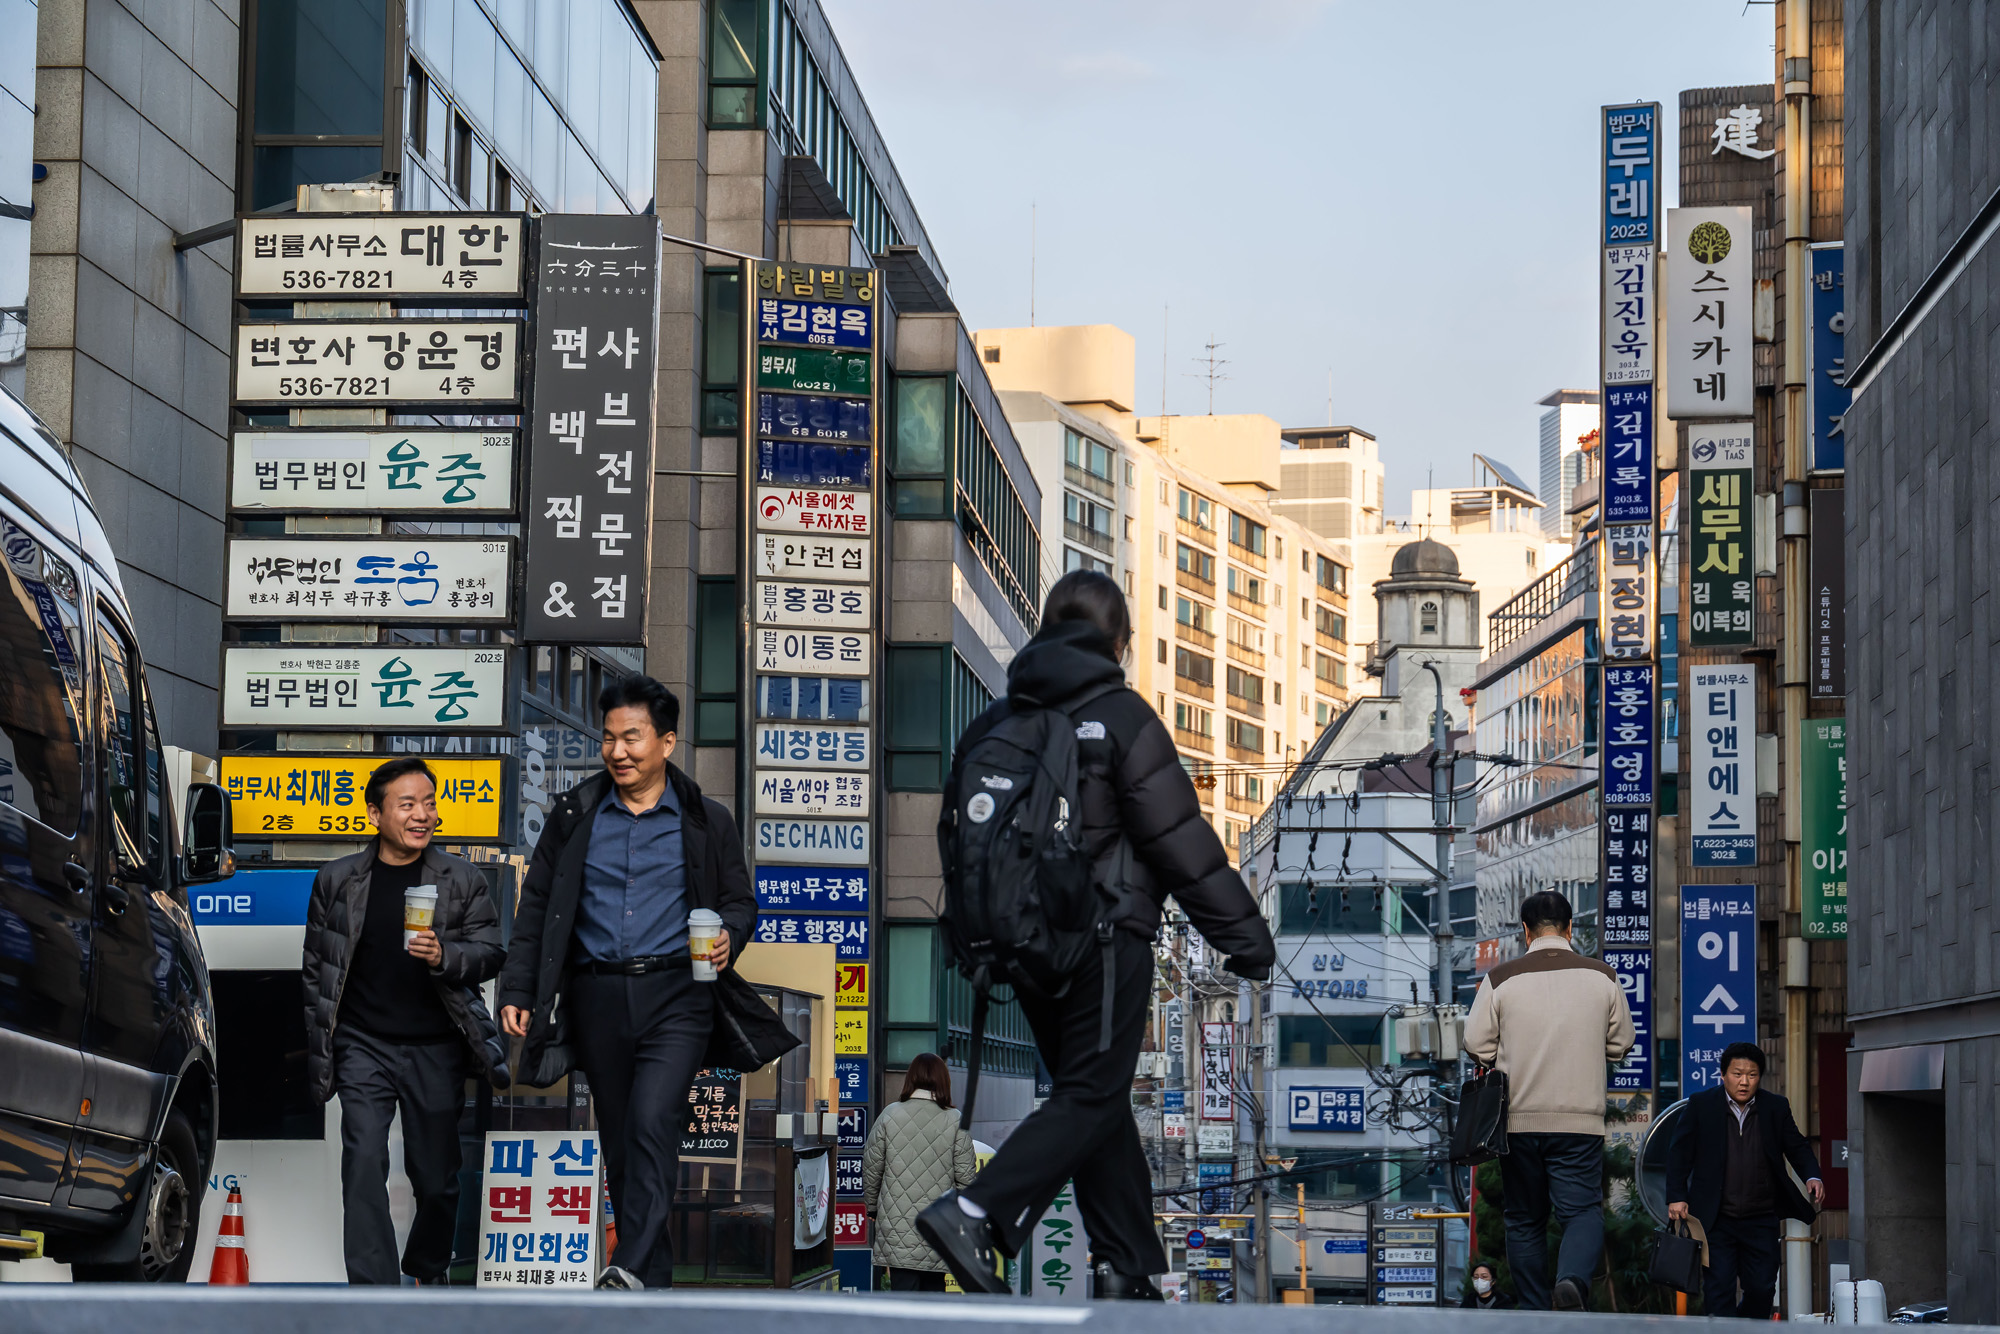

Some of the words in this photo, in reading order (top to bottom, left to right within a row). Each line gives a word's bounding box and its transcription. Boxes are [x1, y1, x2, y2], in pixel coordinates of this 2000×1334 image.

[1608, 112, 1652, 134] 법무사
[1608, 136, 1650, 218] 두레
[1610, 222, 1648, 239] 202호
[254, 233, 388, 259] 법률사무소
[400, 224, 509, 267] 대한
[1608, 246, 1650, 265] 법무사
[547, 258, 647, 278] 六分三十
[282, 270, 394, 289] 536-7821
[441, 269, 479, 290] 4층
[758, 265, 874, 301] 하림빌딩
[761, 299, 779, 341] 법무사
[781, 304, 868, 337] 김현옥
[1611, 264, 1648, 360] 김진욱
[807, 333, 836, 345] 605호
[1691, 269, 1731, 402] 스시카네
[250, 335, 356, 367] 변호사
[367, 330, 503, 371] 강윤경
[761, 355, 797, 375] 법무사
[1607, 369, 1651, 380] 313-2577
[1618, 361, 1640, 369] 303호
[279, 377, 391, 396] 536-7821
[438, 376, 476, 395] 4층
[1609, 391, 1648, 406] 법무사
[482, 435, 512, 448] 302호
[816, 428, 848, 439] 601호
[1718, 437, 1751, 448] 세무그룹
[1611, 411, 1646, 489] 김기록
[254, 460, 367, 491] 법무법인
[378, 438, 487, 504] 윤중
[591, 326, 640, 619] 샤브전문점
[786, 490, 855, 511] 서울에셋
[1614, 494, 1642, 504] 203호
[798, 511, 868, 532] 투자자문
[1697, 473, 1744, 575] 세무사
[1609, 524, 1650, 540] 변호사
[482, 542, 507, 555] 301호
[783, 544, 862, 570] 안권섭
[247, 556, 342, 585] 법무법인
[354, 550, 440, 607] 도움
[455, 577, 486, 591] 변호사
[248, 591, 280, 605] 변호사
[285, 590, 335, 608] 최석두
[343, 590, 392, 608] 곽규홍
[446, 590, 495, 609] 홍광의
[763, 584, 778, 622] 법무사
[783, 586, 863, 614] 홍광호
[1610, 540, 1650, 647] 박정현
[1820, 586, 1831, 630] 스튜디오
[1692, 610, 1751, 633] 이복희
[474, 652, 503, 665] 202호
[762, 631, 777, 669] 법무사
[783, 634, 863, 662] 이동윤
[1614, 647, 1642, 659] 2층
[1820, 635, 1831, 680] 프로필름
[279, 659, 303, 670] 변호사
[306, 658, 332, 670] 박현근
[1606, 668, 1652, 685] 변호사
[1696, 673, 1749, 687] 법률사무소
[246, 677, 357, 708] 법무법인
[370, 655, 480, 723] 윤중
[1608, 687, 1649, 782] 홍호영
[759, 730, 865, 763] 세창합동
[1828, 741, 1845, 749] Law
[1706, 688, 1741, 830] 티앤에스
[227, 774, 282, 801] 법무사
[440, 778, 495, 804] 사무소
[761, 777, 830, 805] 서울생약
[1616, 783, 1641, 792] 301호
[1605, 793, 1651, 803] 508-0635
[261, 814, 294, 832] 2층
[759, 822, 864, 850] SECHANG
[1711, 850, 1738, 860] 302호
[758, 879, 801, 895] 법무법인
[801, 877, 868, 902] 무궁화
[196, 895, 251, 913] one
[768, 896, 791, 904] 205호
[1683, 897, 1753, 921] 법률사무소
[758, 918, 800, 943] 성훈
[803, 919, 868, 944] 행정사
[1605, 915, 1649, 928] 천일기획
[840, 945, 863, 955] 301호
[1312, 953, 1345, 972] 신신
[1604, 953, 1651, 970] 행정사
[1692, 930, 1746, 1034] 이수
[1614, 1077, 1641, 1086] 501호
[693, 1104, 740, 1122] 막국수
[1322, 1110, 1362, 1124] 주차장
[1377, 1231, 1384, 1241] 6
[484, 1232, 589, 1264] 개인회생
[1377, 1250, 1384, 1260] 5
[483, 1270, 512, 1282] 법무사
[516, 1269, 556, 1285] 최재홍
[559, 1270, 588, 1282] 사무소
[1377, 1269, 1384, 1279] 4
[1377, 1289, 1384, 1299] 4
